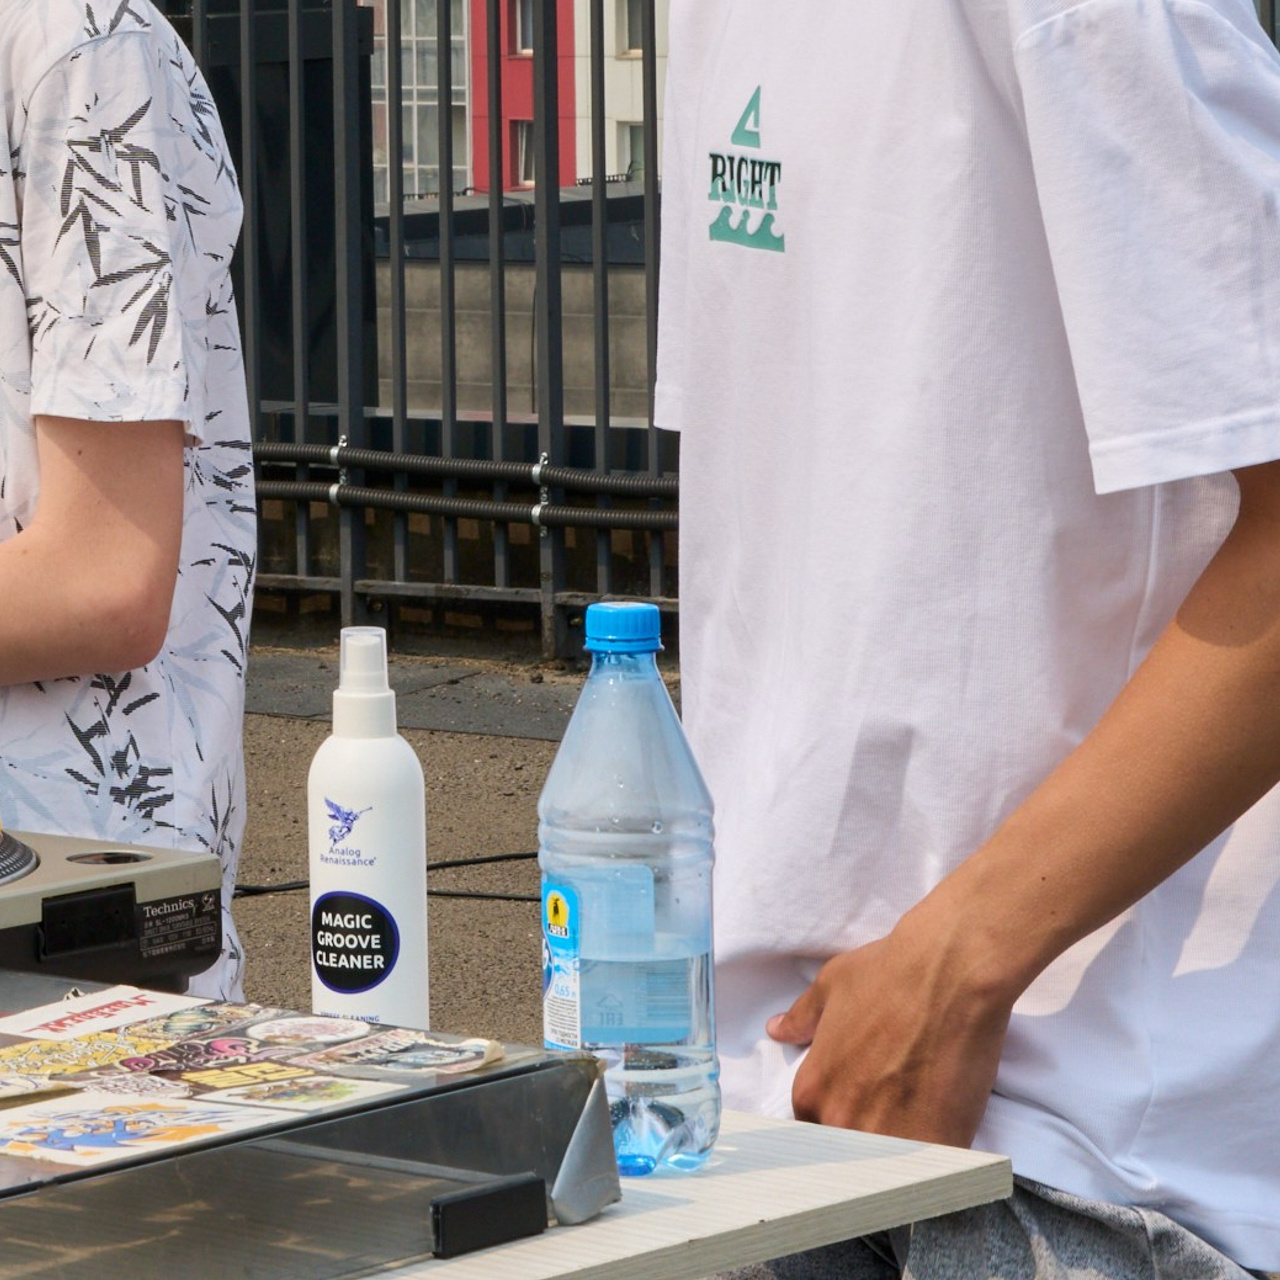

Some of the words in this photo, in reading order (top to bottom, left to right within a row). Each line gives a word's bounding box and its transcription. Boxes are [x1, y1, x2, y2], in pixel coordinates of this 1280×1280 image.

[708, 152, 781, 211] RIGHT
[320, 854, 375, 866] Renaissance
[329, 847, 361, 858] Analog
[143, 899, 195, 918] Technics
[321, 911, 372, 929] MAGIC
[317, 931, 381, 949] GROOVE
[316, 950, 384, 969] CLEANER
